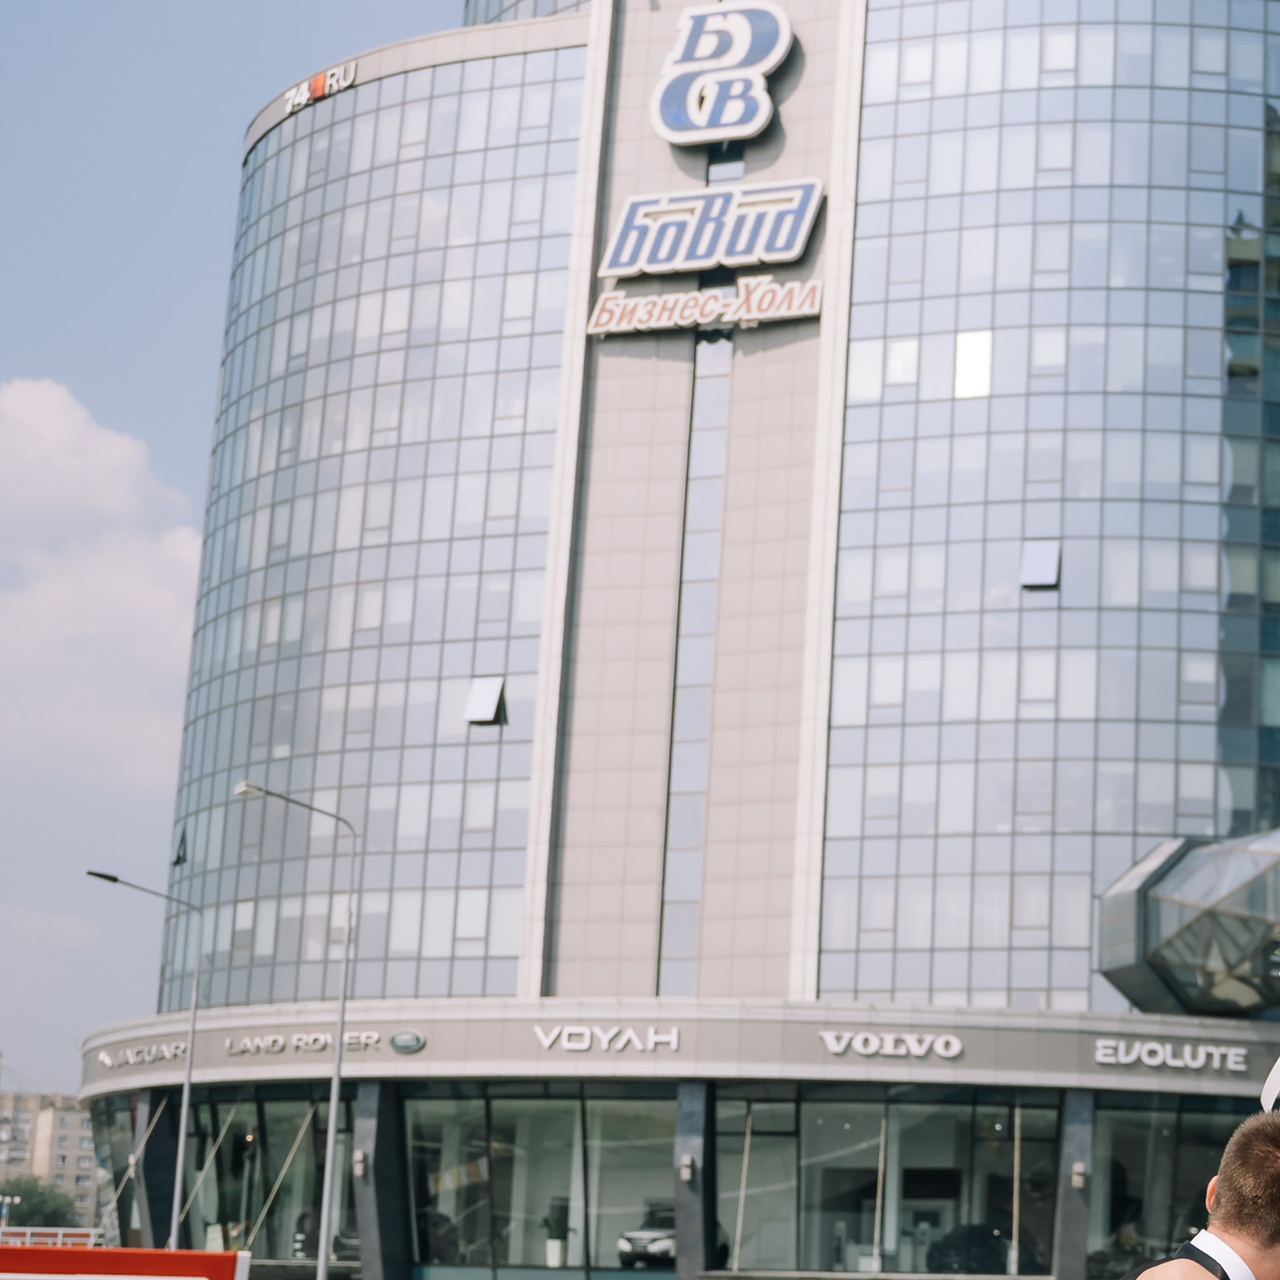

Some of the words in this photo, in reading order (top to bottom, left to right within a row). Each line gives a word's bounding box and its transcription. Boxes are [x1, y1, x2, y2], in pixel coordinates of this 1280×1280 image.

[590, 281, 820, 330] Бизнес-Холл
[225, 1033, 286, 1056] LAND
[533, 1025, 679, 1052] VOYAH
[819, 1030, 963, 1059] VOLVO
[117, 1041, 187, 1068] JAGUAR
[1095, 1038, 1248, 1071] EVOLUTE
